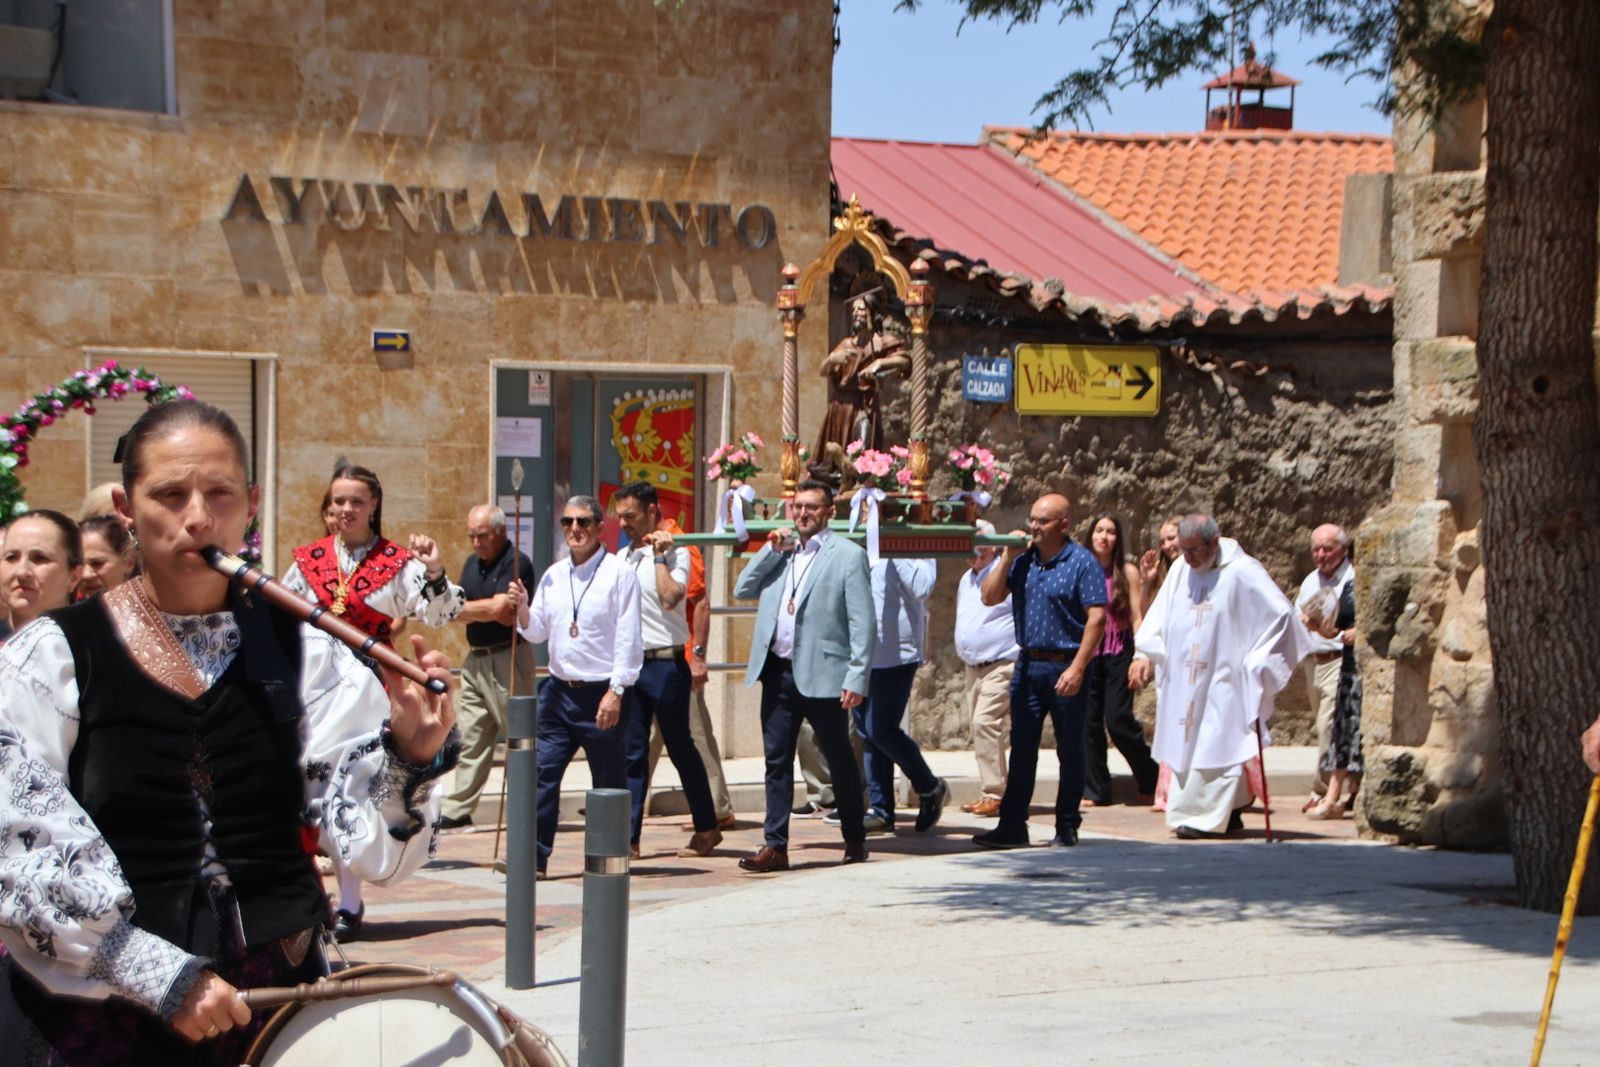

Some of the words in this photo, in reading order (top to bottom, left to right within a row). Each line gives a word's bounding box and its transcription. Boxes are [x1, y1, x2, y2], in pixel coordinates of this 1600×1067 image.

[221, 172, 777, 250] AYUNTAMIENTO
[967, 360, 1008, 377] CALLE
[966, 379, 1006, 398] CALZADA
